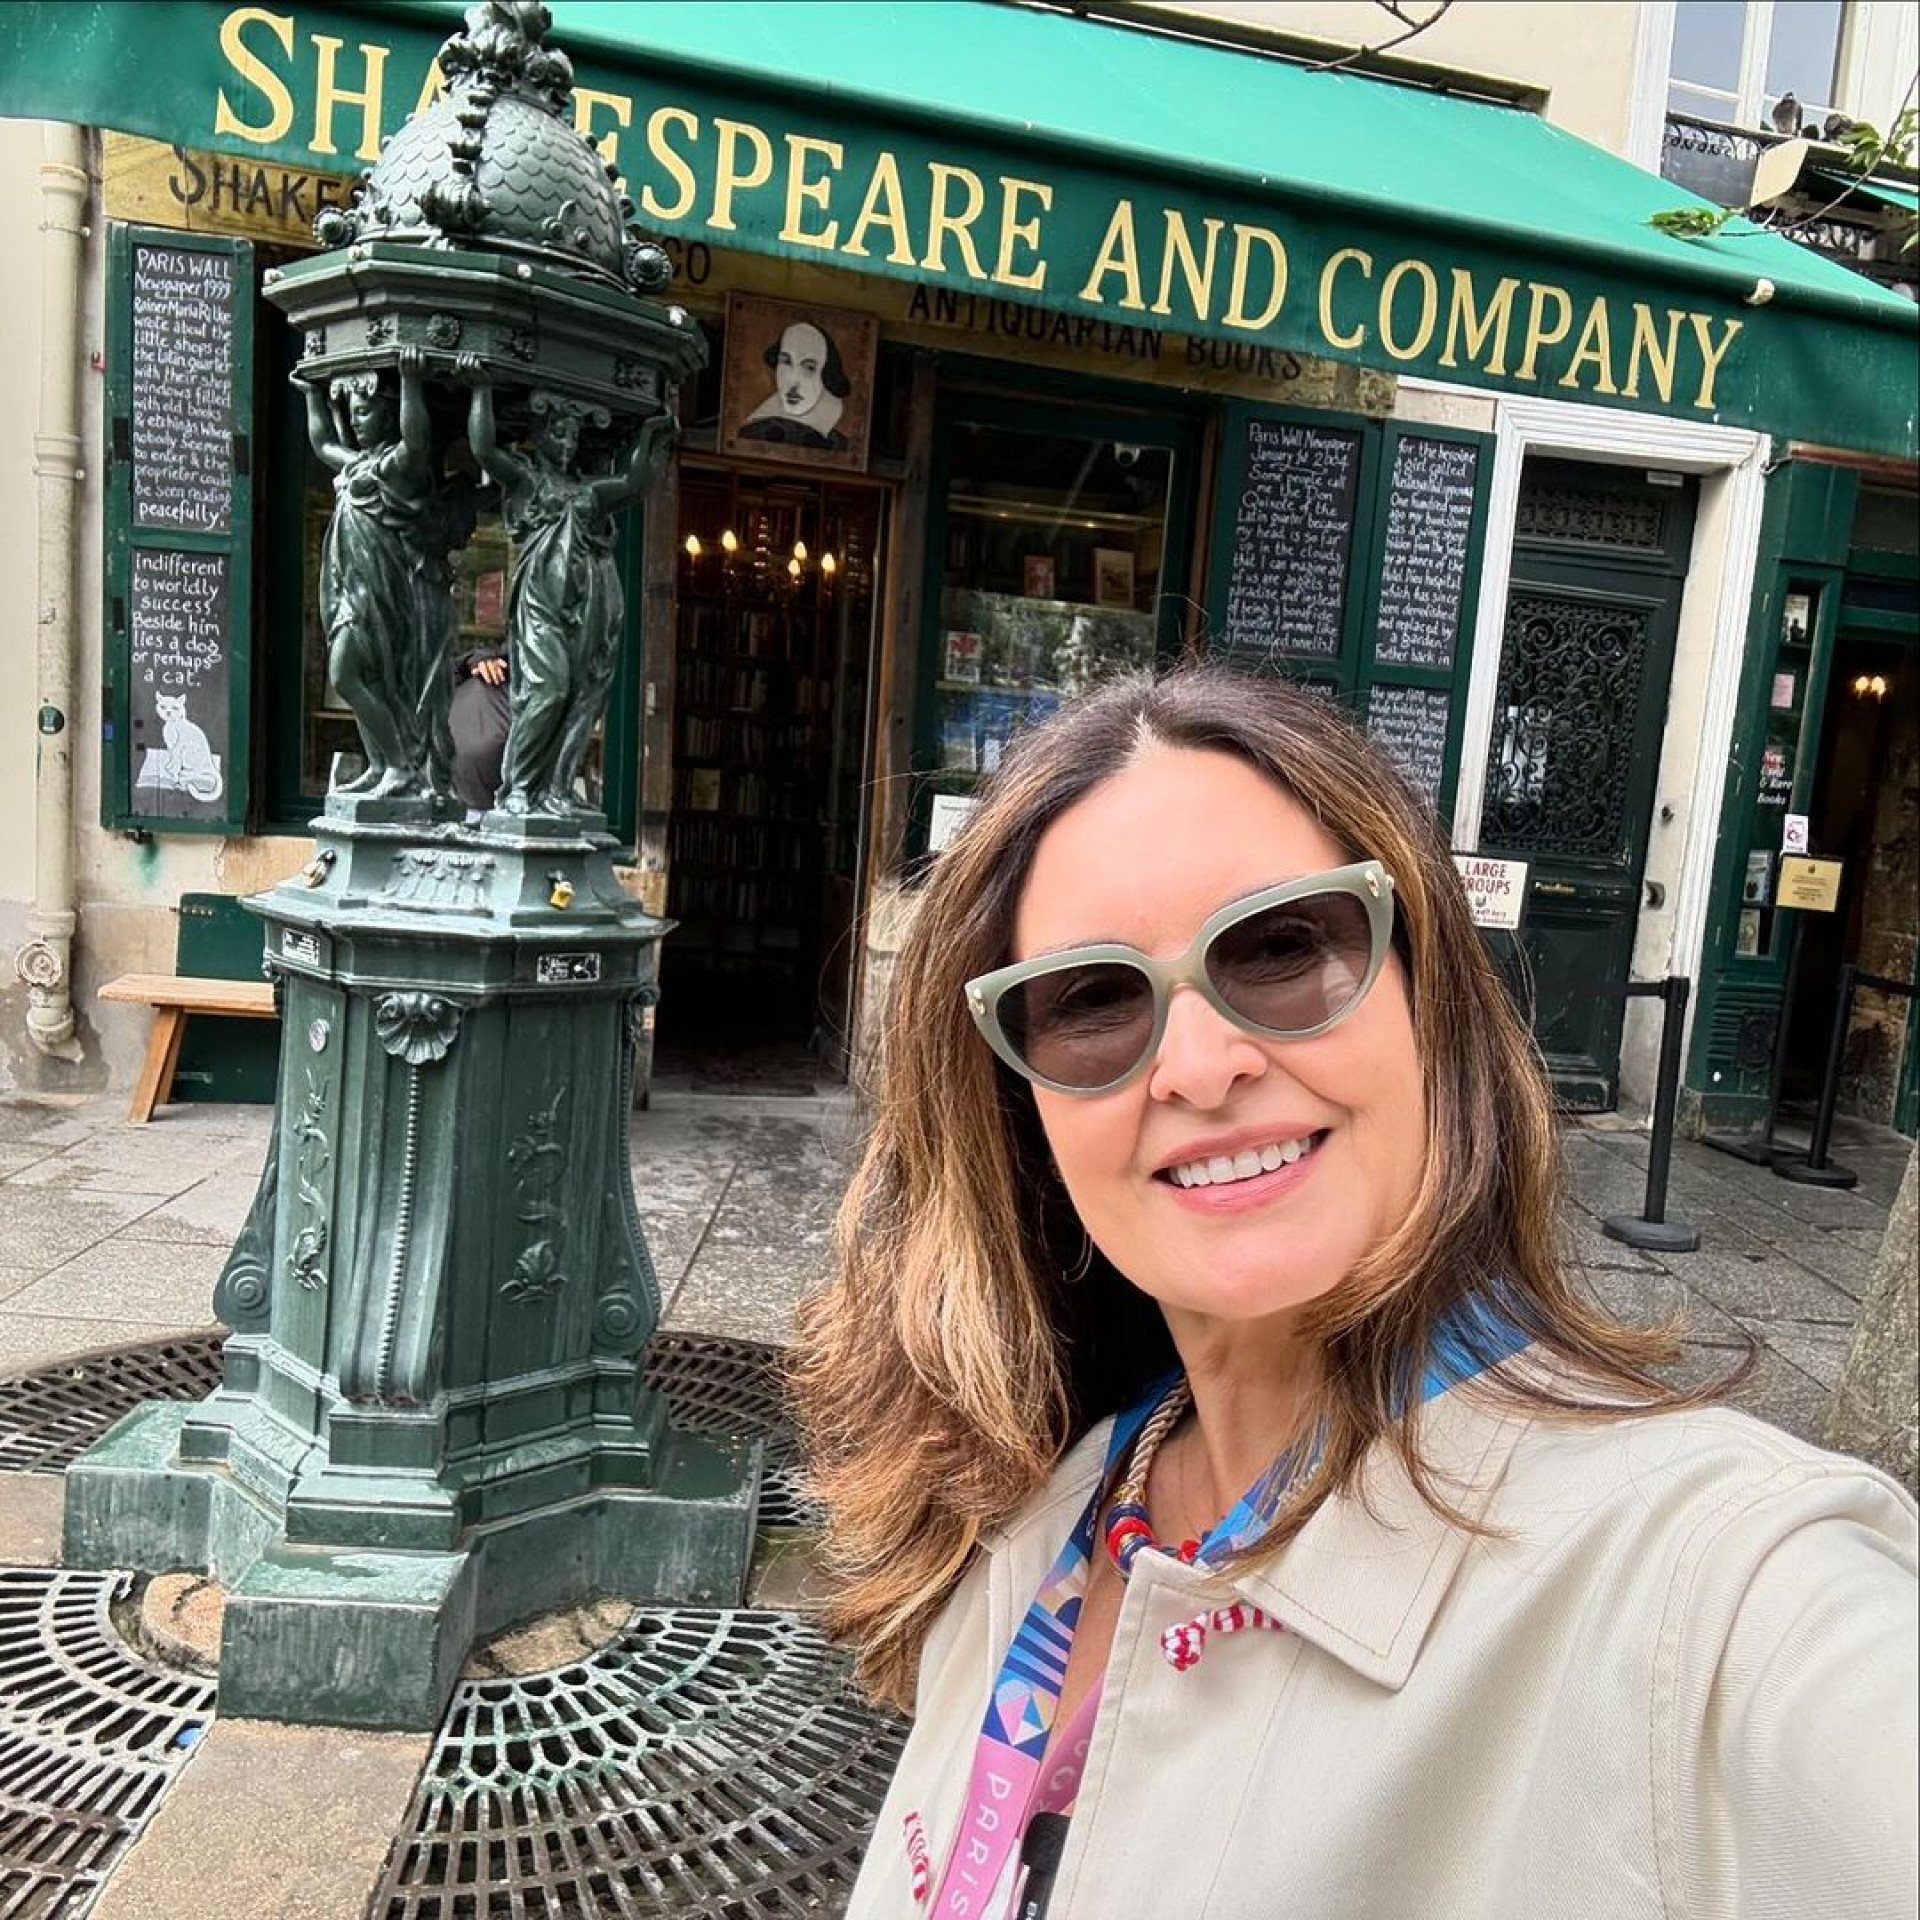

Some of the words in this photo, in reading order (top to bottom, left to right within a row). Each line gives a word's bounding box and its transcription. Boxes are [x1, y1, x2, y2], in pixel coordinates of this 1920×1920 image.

[214, 7, 1053, 290] SHESPEARE
[1079, 200, 1288, 330] AND
[1317, 248, 1744, 409] COMPANY
[136, 248, 185, 274] PARIS
[189, 256, 233, 281] WALL
[203, 278, 232, 301] 1999
[173, 320, 206, 338] about
[212, 323, 232, 341] the
[134, 347, 156, 362] the
[173, 336, 213, 358] shops
[214, 341, 232, 364] of
[1185, 335, 1302, 381] BOOKS
[134, 362, 161, 380] with
[134, 380, 193, 400] windows
[196, 387, 231, 409] filled
[134, 395, 161, 412] with
[163, 397, 183, 414] old
[204, 454, 230, 471] the
[139, 498, 225, 530] peacefully.
[136, 552, 224, 577] Indifferent
[133, 572, 150, 592] to
[152, 575, 219, 601] worldly
[132, 611, 184, 632] Beside
[189, 614, 220, 636] him
[134, 629, 163, 648] lies
[168, 635, 179, 650] a
[184, 634, 222, 664] dog
[131, 651, 148, 664] or
[153, 651, 212, 673] perhaps
[143, 668, 154, 683] a
[1464, 860, 1507, 879] LARGE
[1464, 876, 1511, 895] ROUPS
[950, 1770, 1013, 1917] PARIS
